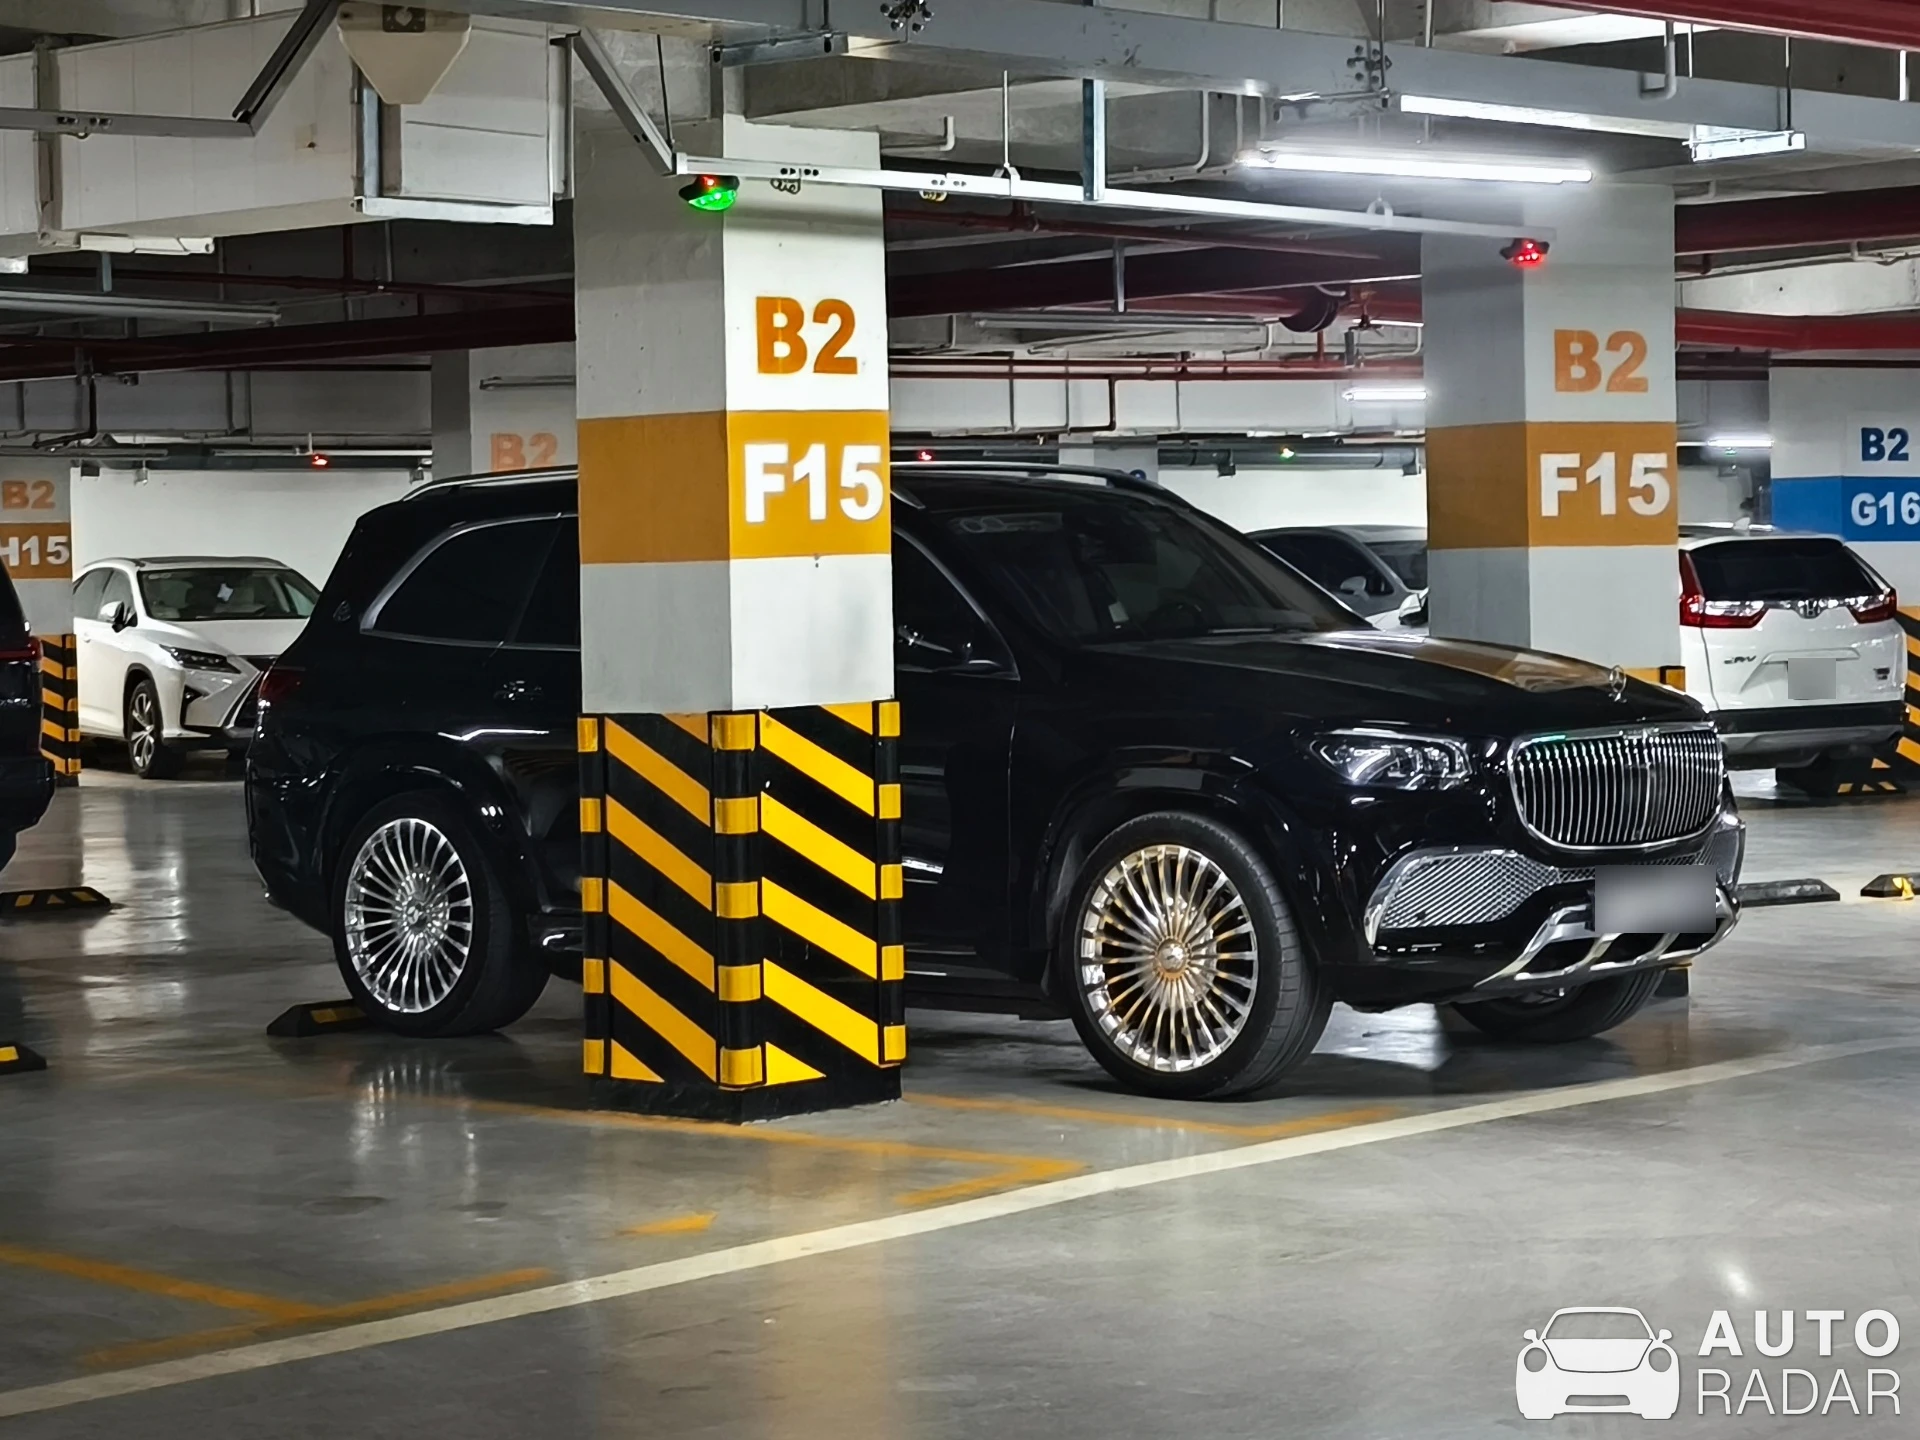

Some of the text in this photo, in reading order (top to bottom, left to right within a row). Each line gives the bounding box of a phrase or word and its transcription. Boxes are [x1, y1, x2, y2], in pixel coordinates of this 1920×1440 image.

[756, 296, 858, 375] B2
[1554, 329, 1648, 392] B2
[490, 432, 558, 472] B2
[1861, 427, 1909, 461] B2
[2, 480, 55, 510] B2
[744, 443, 884, 523] F15
[1540, 451, 1671, 516] F15
[1851, 491, 1920, 526] G16
